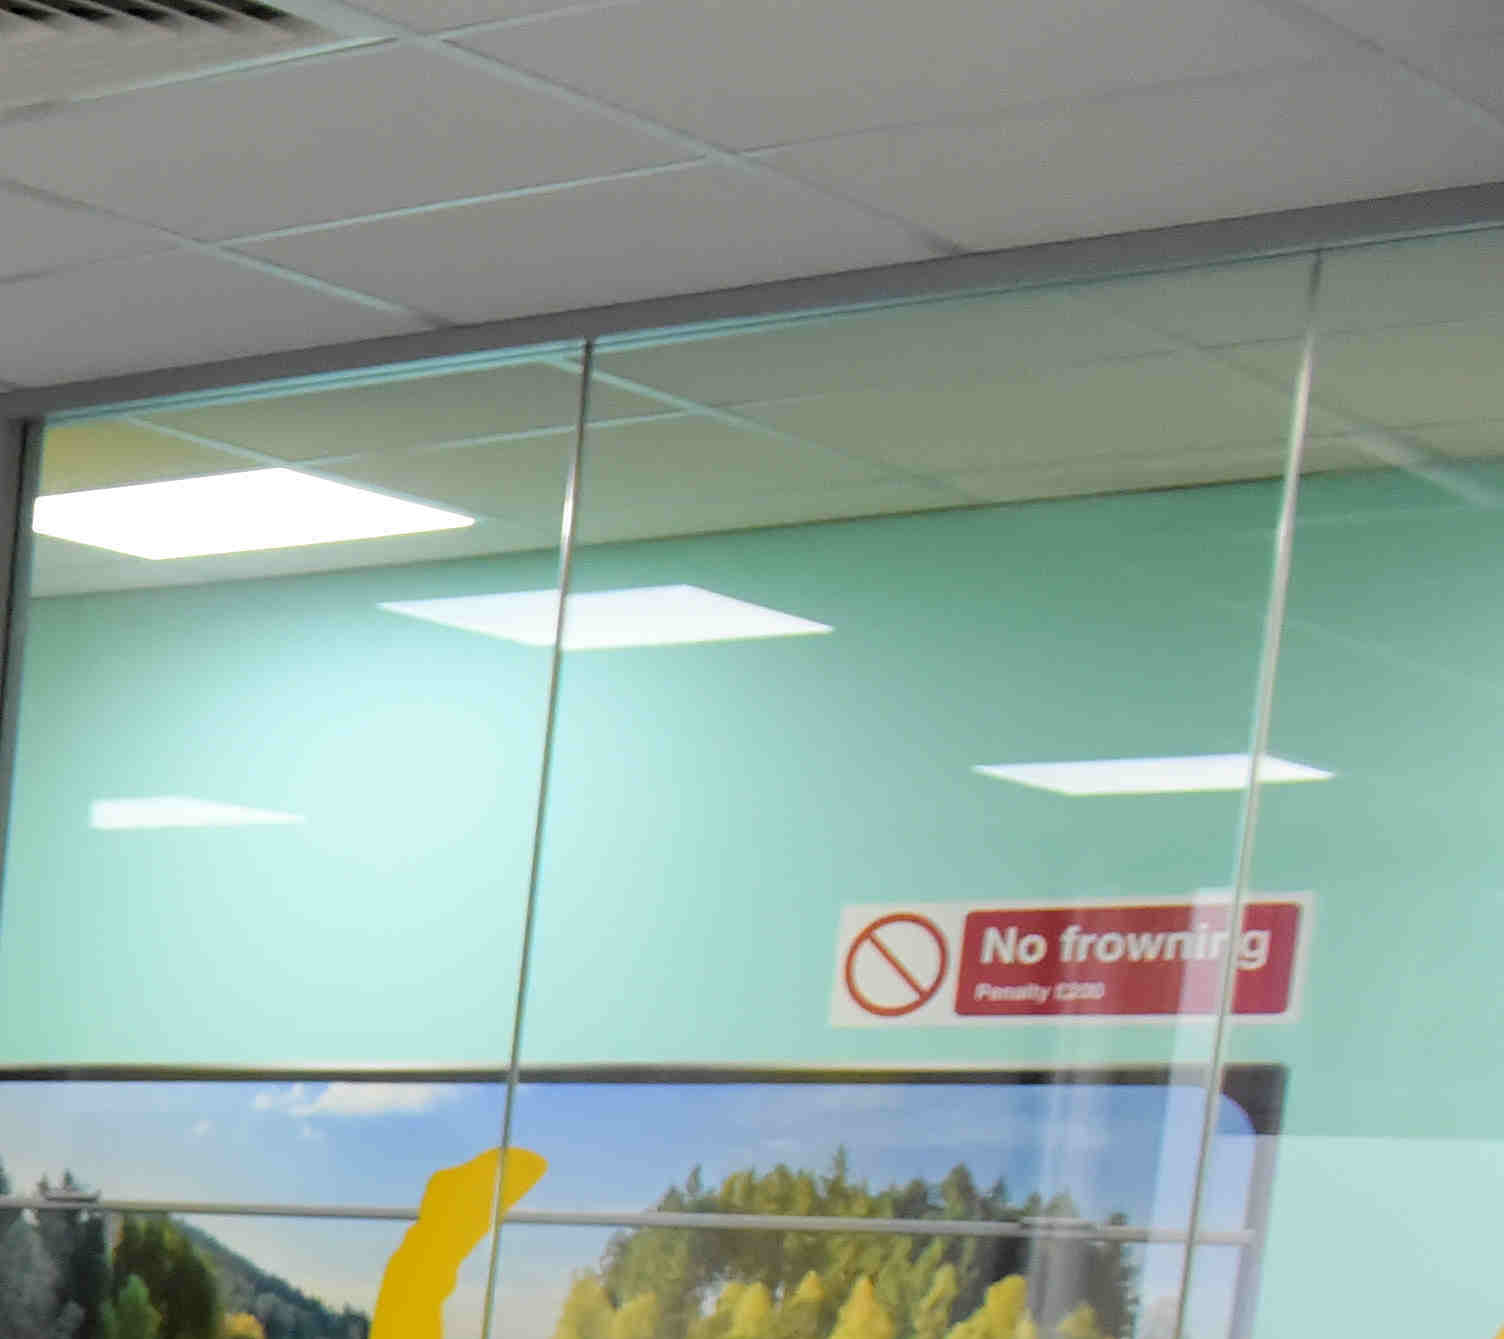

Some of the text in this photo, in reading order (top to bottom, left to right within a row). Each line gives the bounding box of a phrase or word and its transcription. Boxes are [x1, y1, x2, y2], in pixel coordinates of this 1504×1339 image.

[980, 924, 1272, 971] No frowning
[974, 982, 1050, 1005] Penalty
